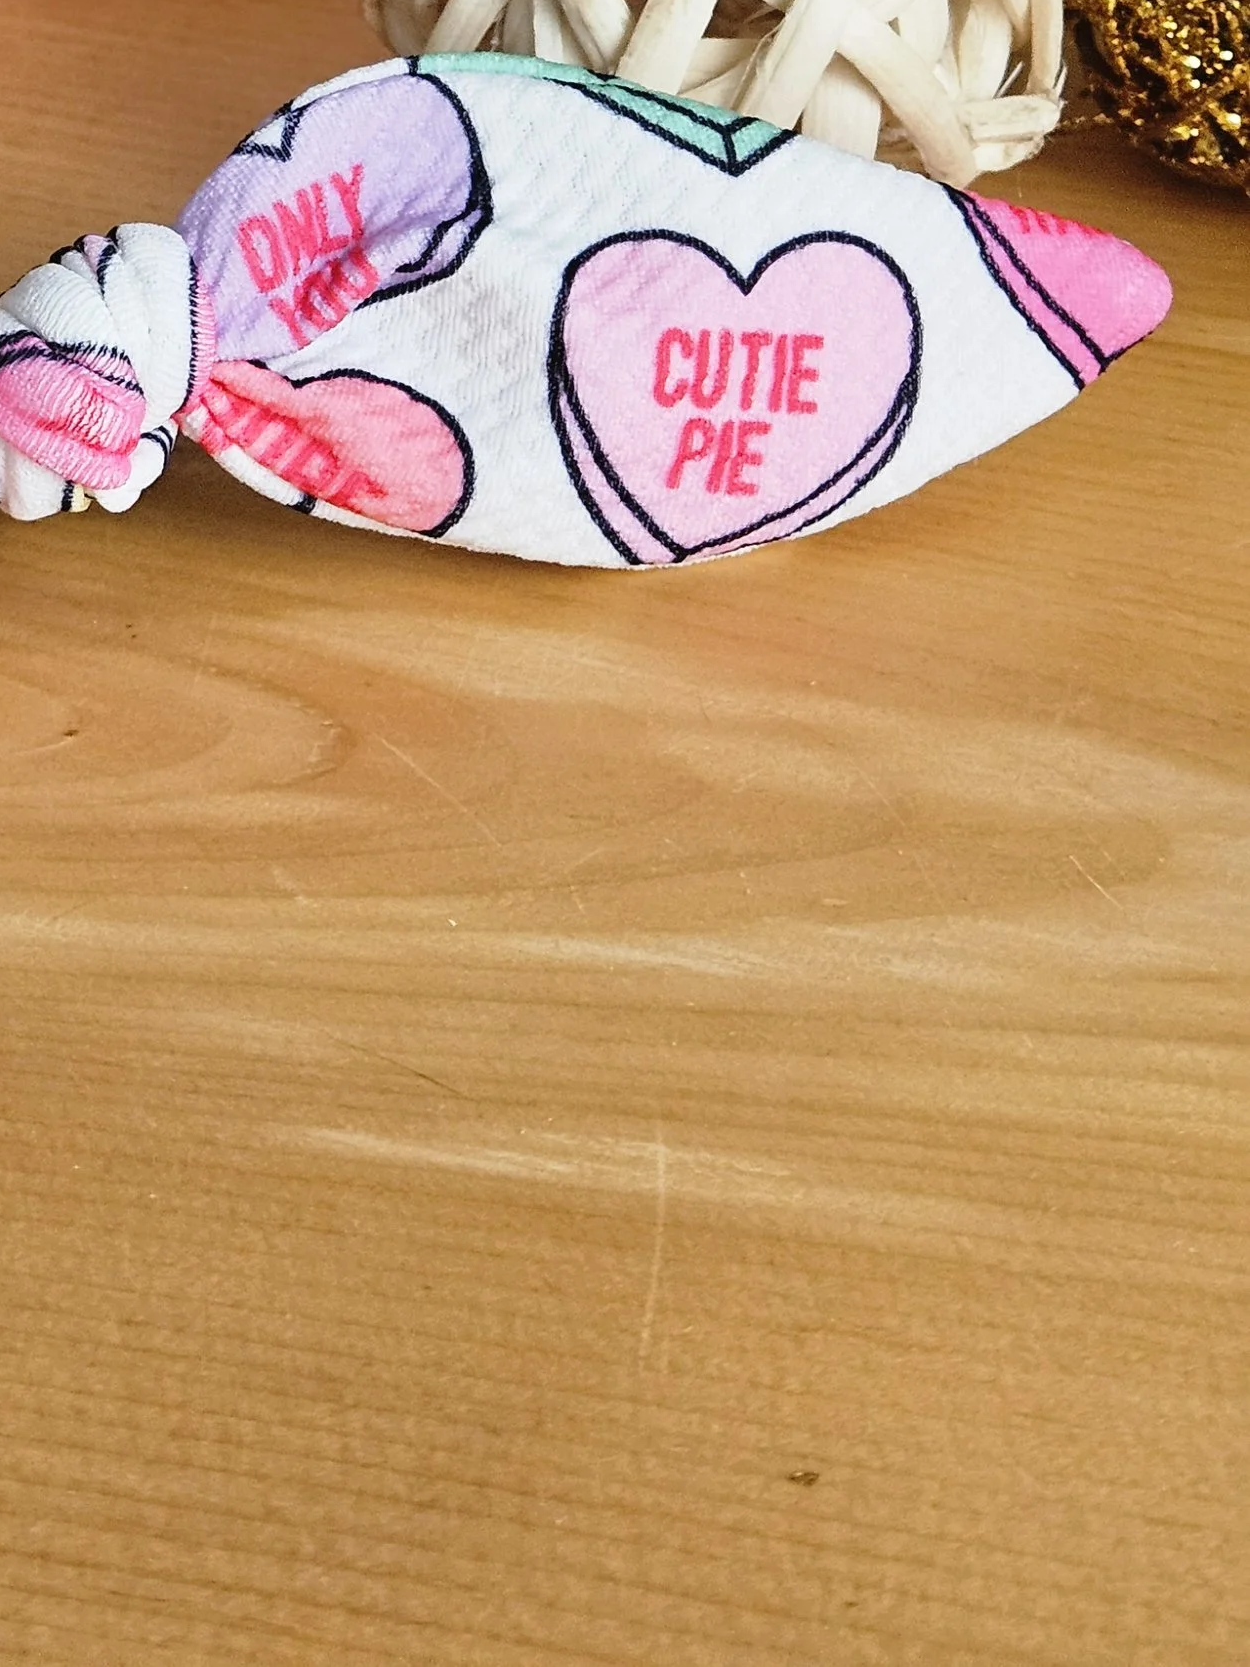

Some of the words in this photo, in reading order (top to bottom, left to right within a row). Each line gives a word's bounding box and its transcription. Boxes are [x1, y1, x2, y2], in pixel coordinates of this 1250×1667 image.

[237, 163, 365, 293] ONLY
[269, 245, 380, 350] YOU
[652, 327, 825, 415] CUTIE
[665, 417, 773, 496] PIE
